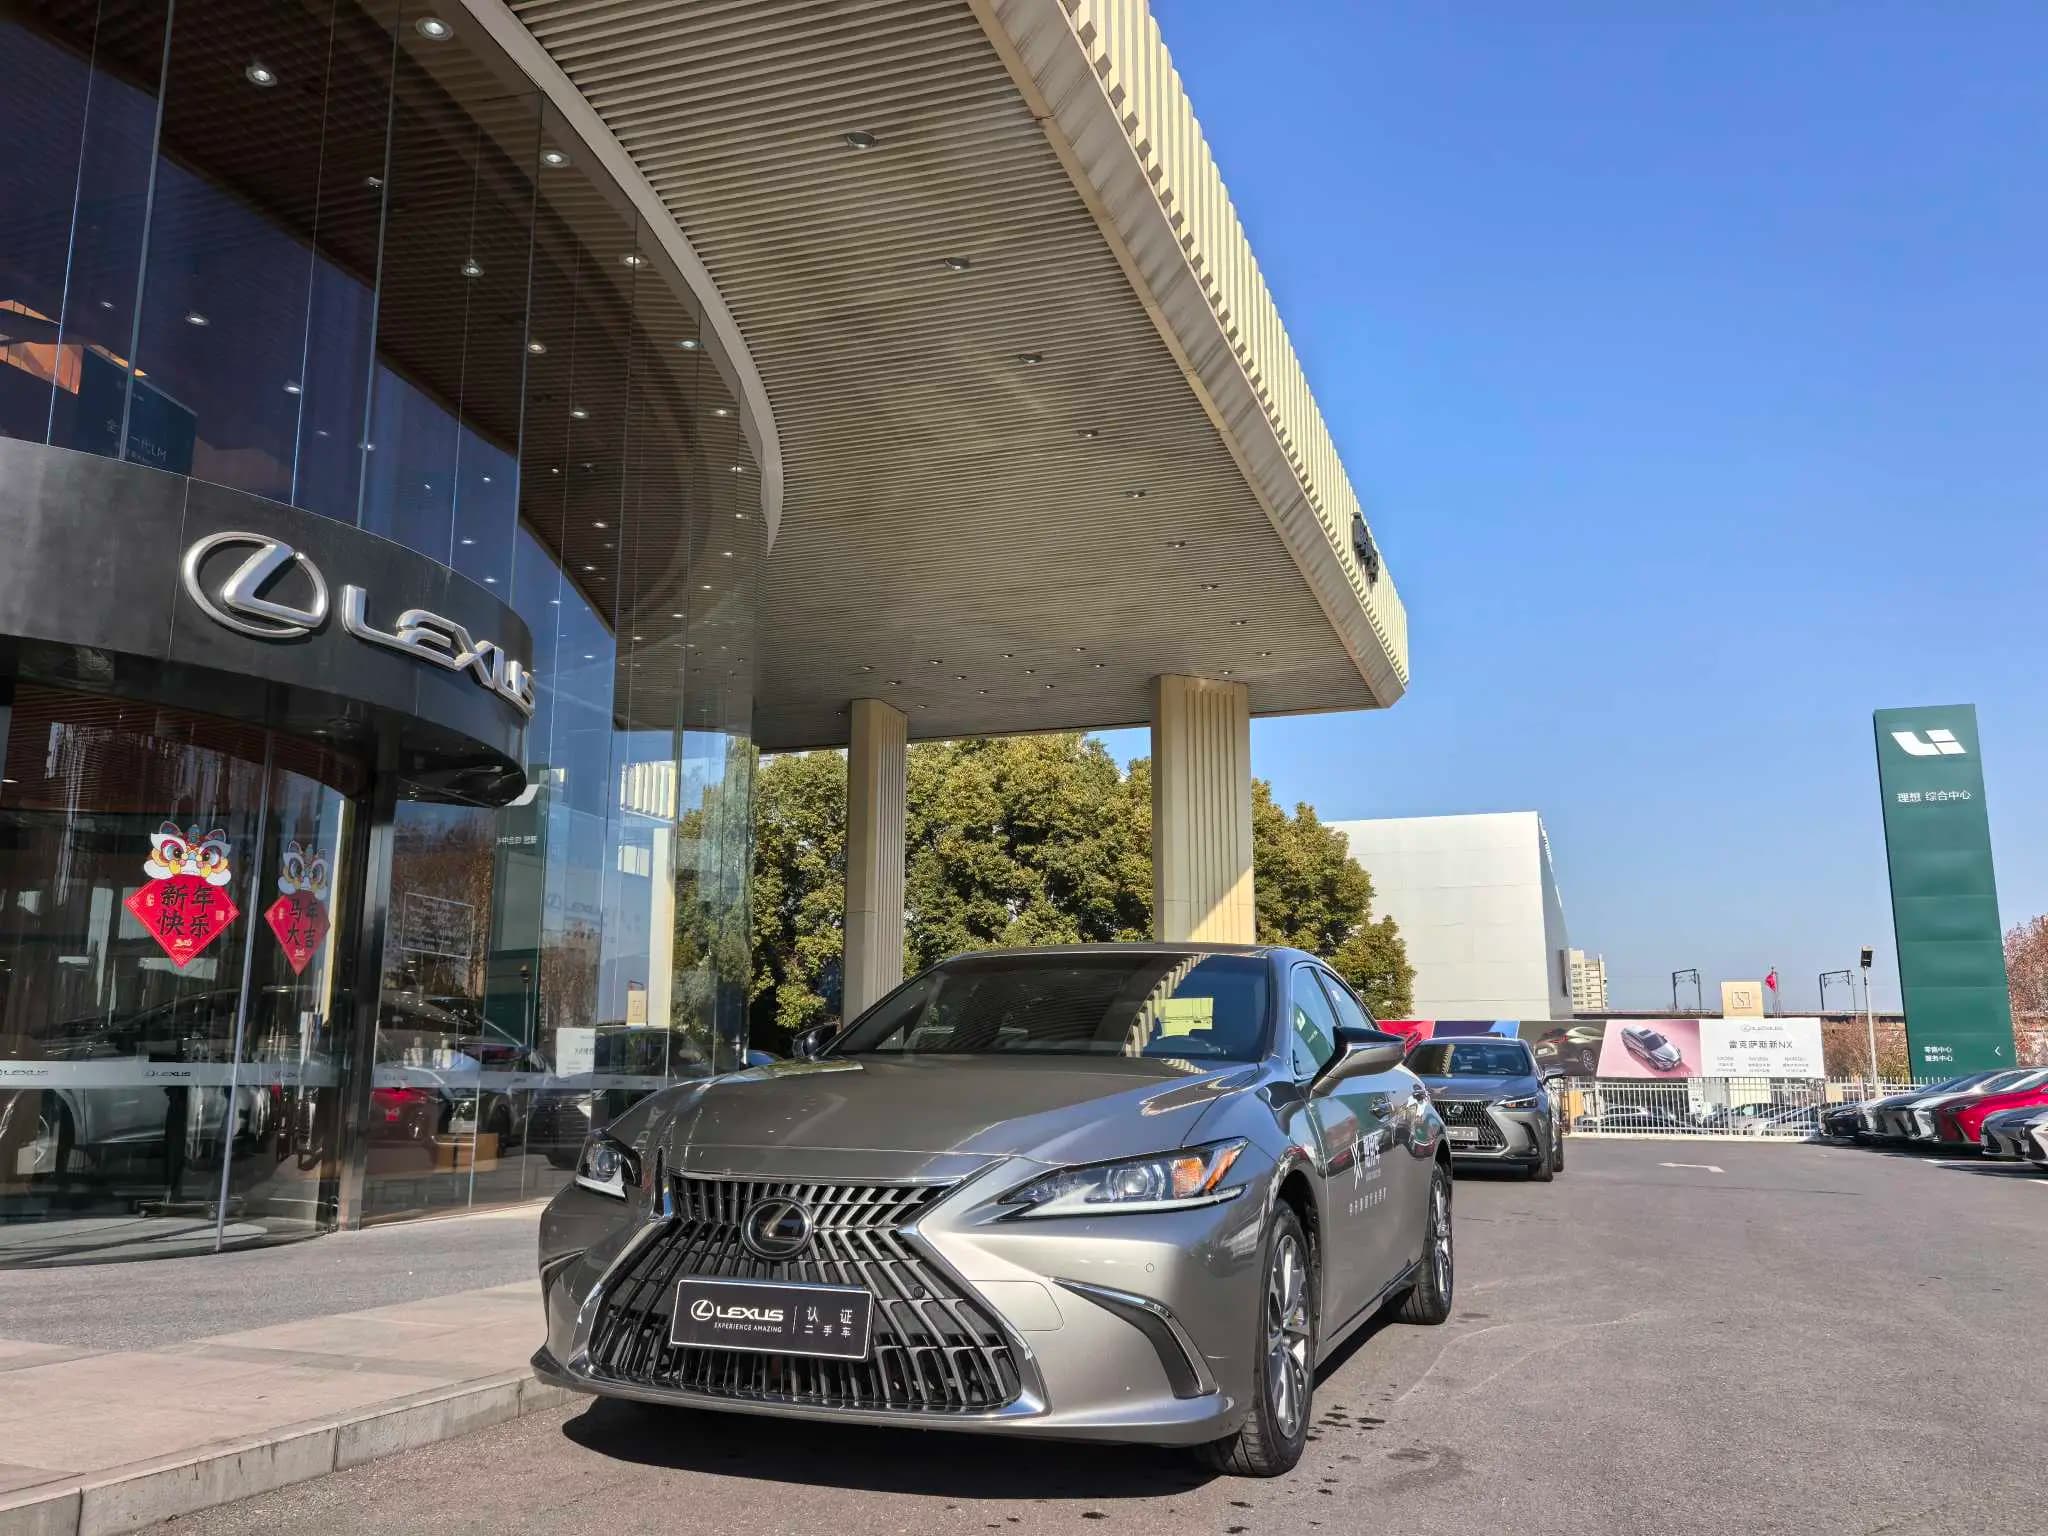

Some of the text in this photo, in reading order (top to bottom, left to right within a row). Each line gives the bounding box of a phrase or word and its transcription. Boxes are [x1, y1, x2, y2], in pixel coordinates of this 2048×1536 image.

[341, 584, 536, 720] LEXUS
[1925, 789, 1972, 802] 综合中心
[160, 883, 215, 912] 新年
[157, 909, 210, 938] 快乐
[286, 920, 316, 949] 大吉
[716, 1306, 784, 1322] LEXUS
[714, 1321, 783, 1333] EXPERIENCE AMAZING
[804, 1324, 852, 1338] 二手车
